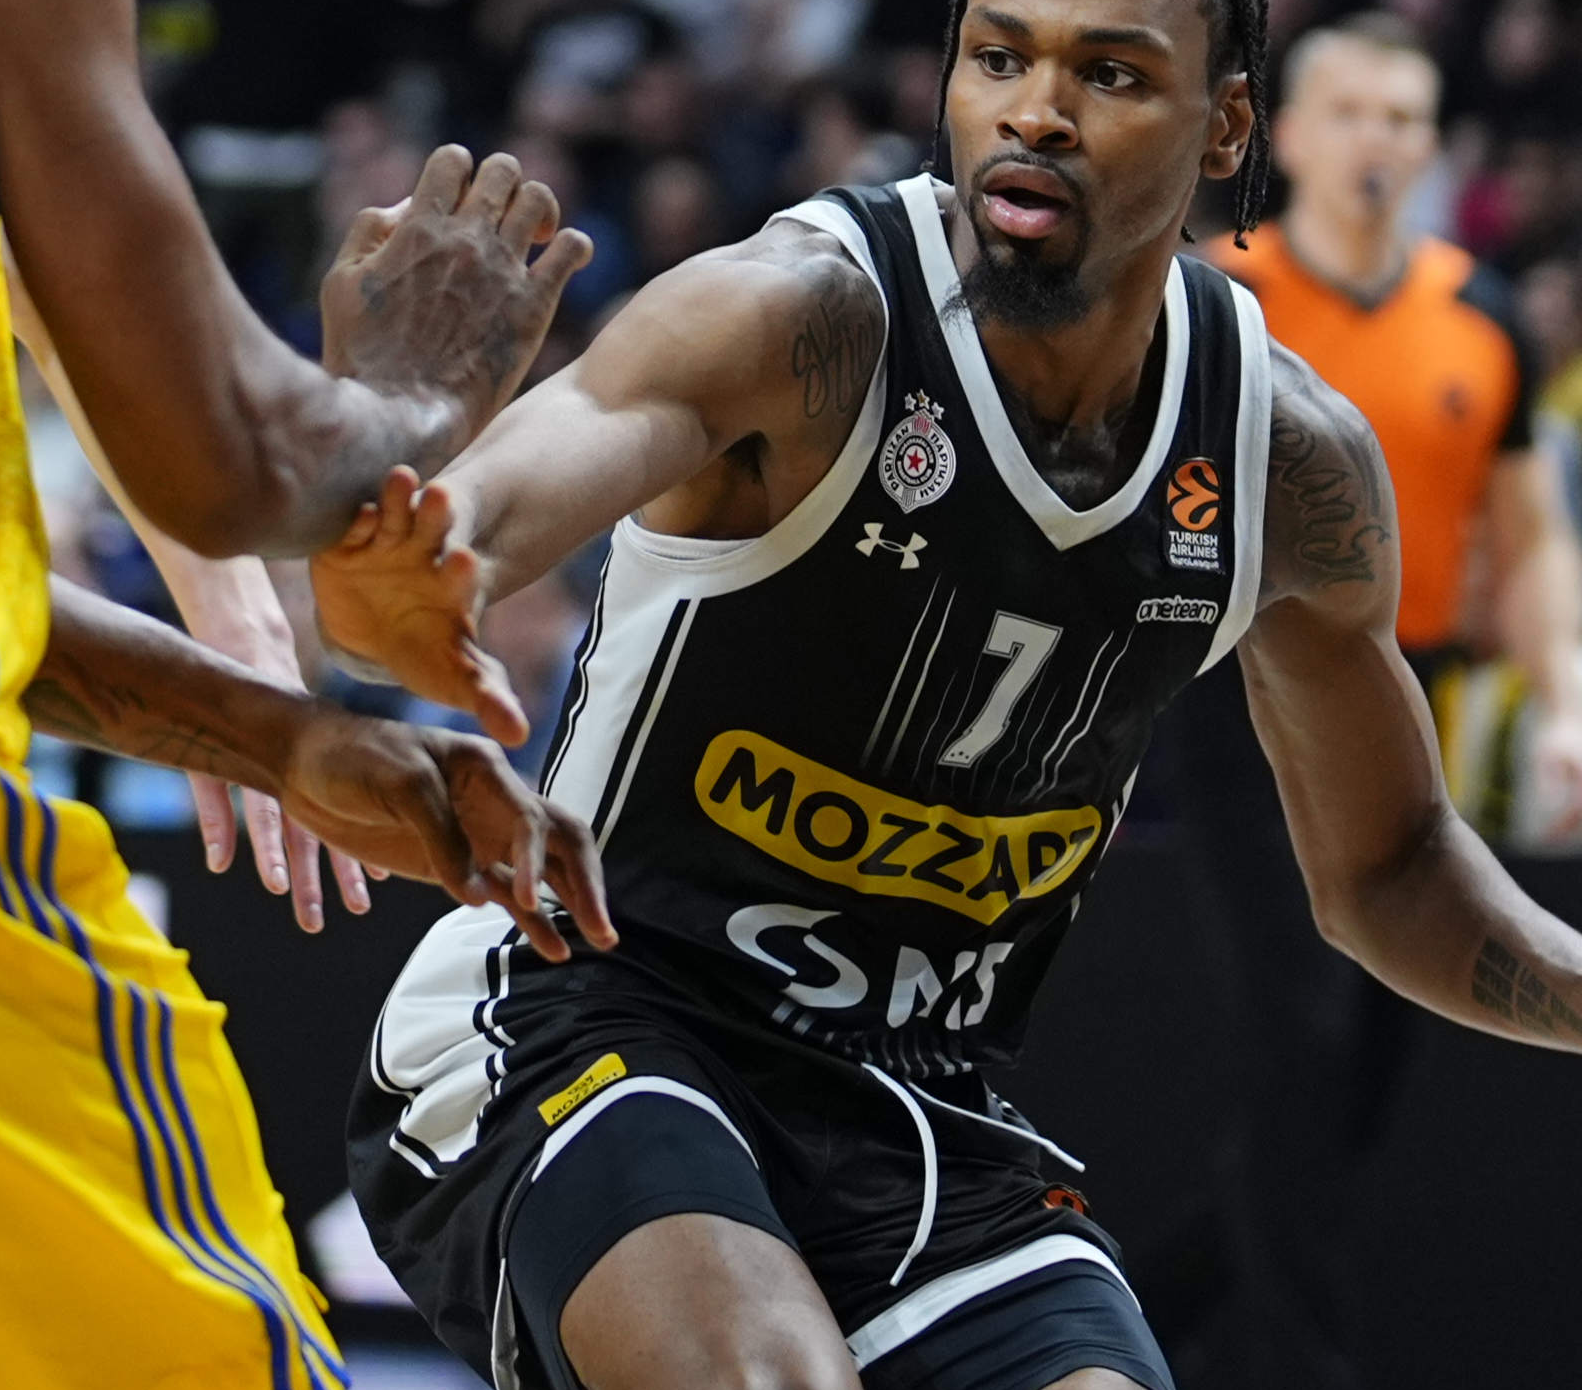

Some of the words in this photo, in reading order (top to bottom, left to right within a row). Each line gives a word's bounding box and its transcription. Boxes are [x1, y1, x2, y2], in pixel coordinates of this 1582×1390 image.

[884, 425, 909, 491] PARTIZAN
[1168, 530, 1218, 547] TURKISH
[1169, 543, 1218, 560] AIRLINES
[937, 609, 1064, 769] 7
